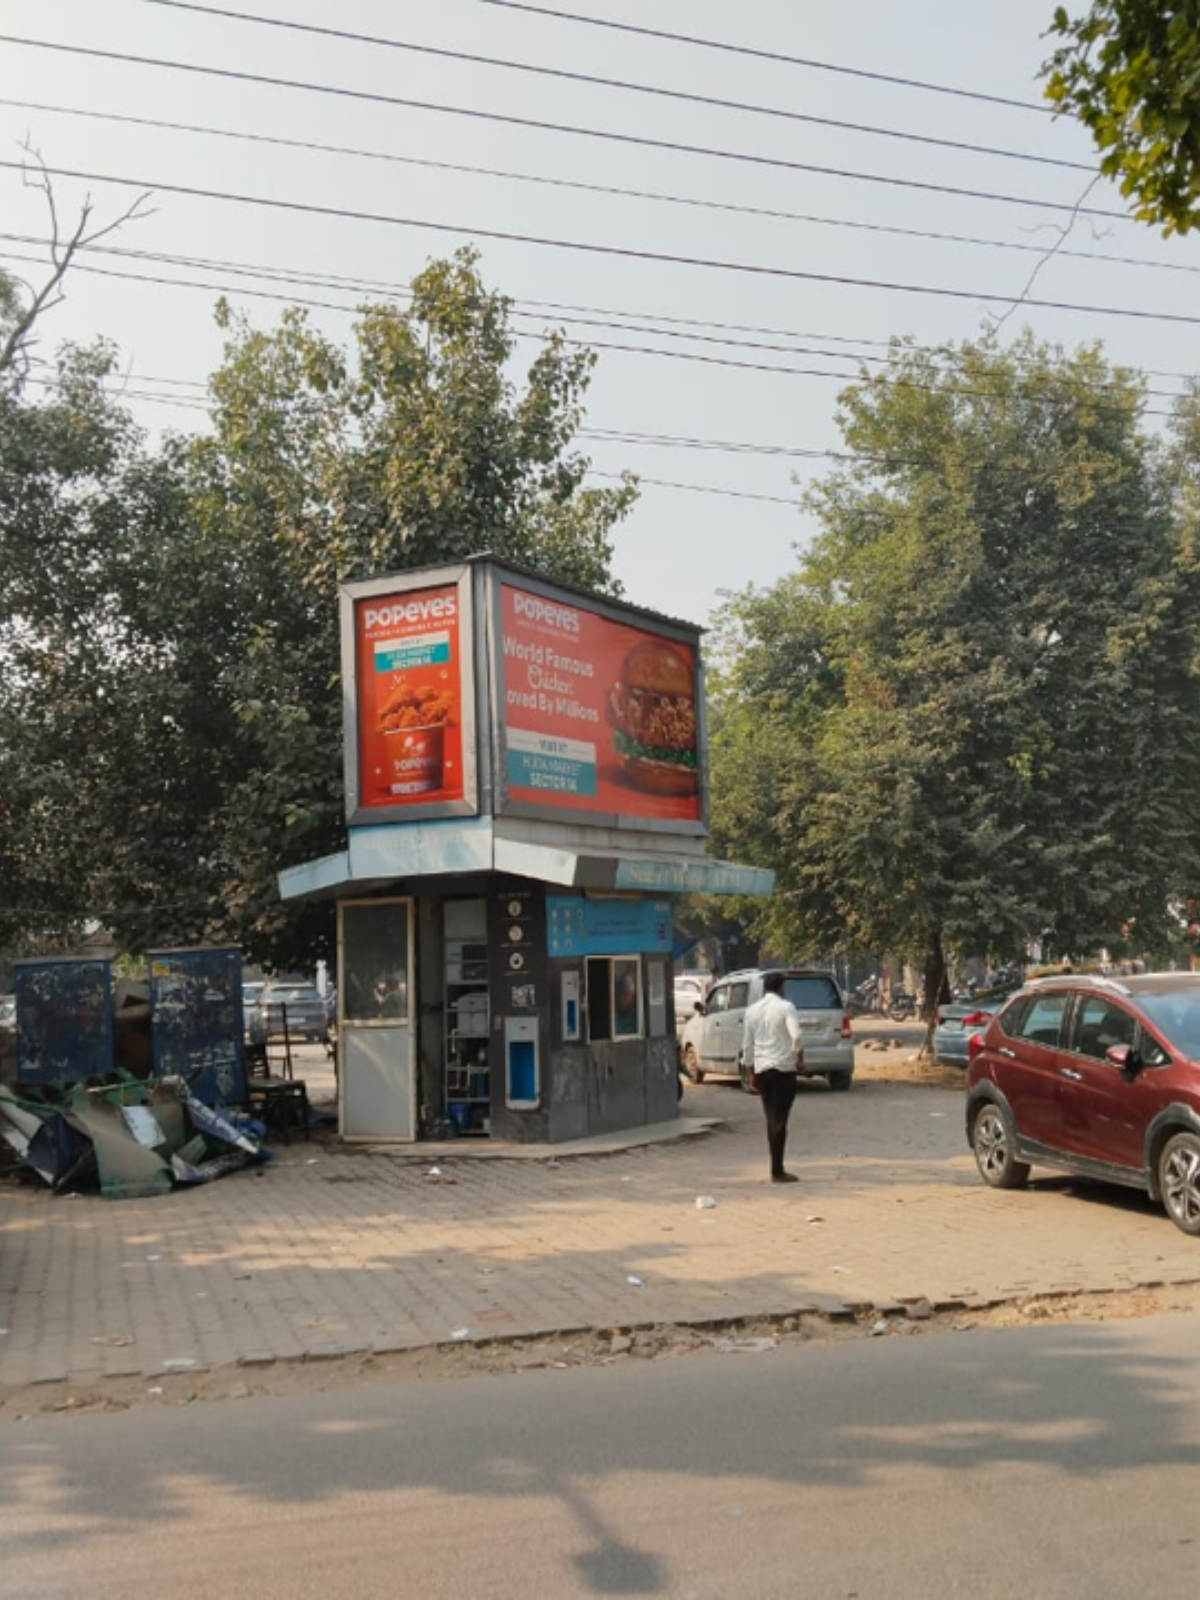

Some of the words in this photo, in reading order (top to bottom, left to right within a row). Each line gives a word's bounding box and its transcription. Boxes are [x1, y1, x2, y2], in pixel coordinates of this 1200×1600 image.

[501, 634, 544, 665] World
[545, 647, 594, 678] Famous
[539, 692, 553, 716] By
[556, 696, 599, 722] Millions
[529, 772, 566, 790] SECTOR
